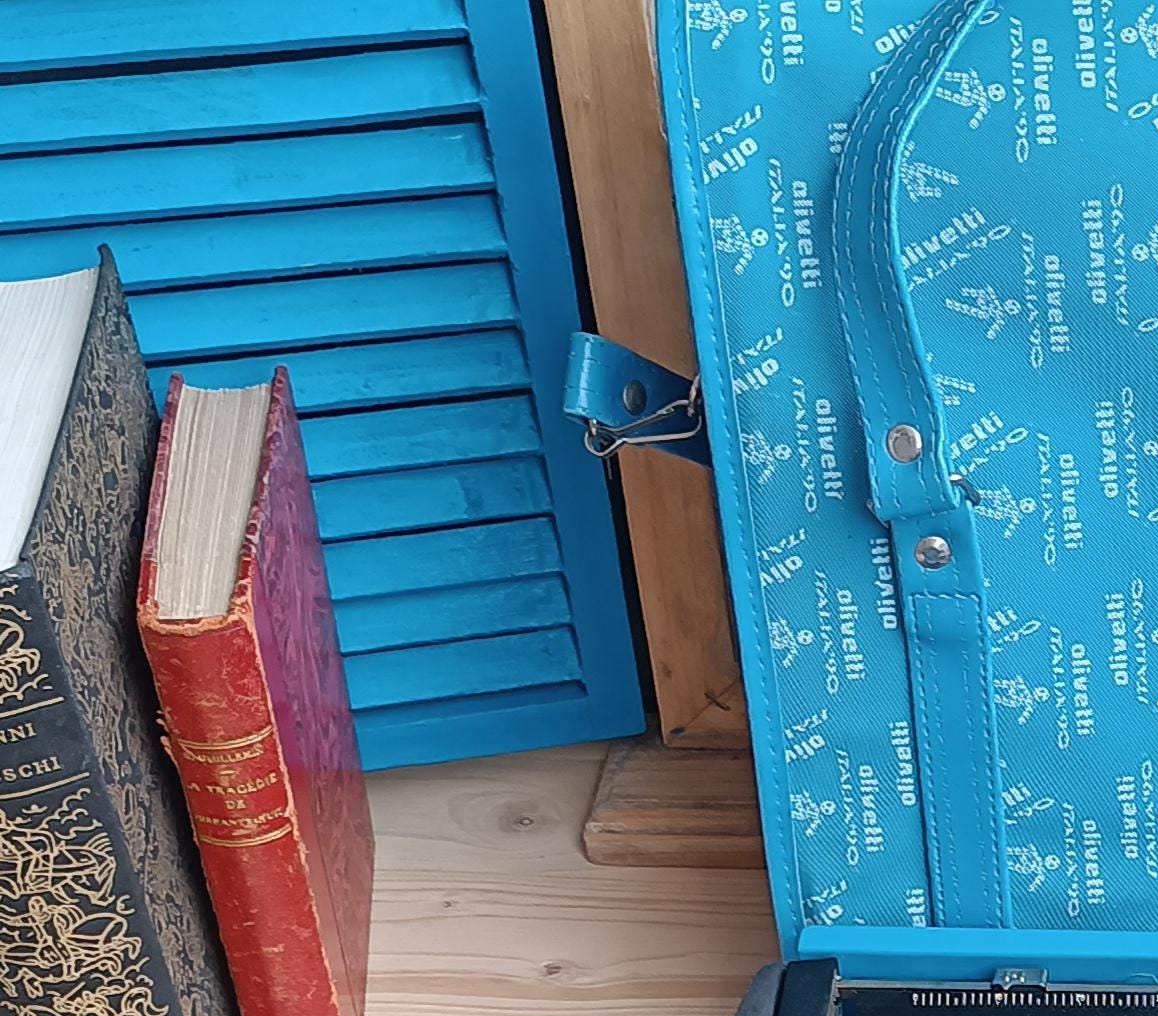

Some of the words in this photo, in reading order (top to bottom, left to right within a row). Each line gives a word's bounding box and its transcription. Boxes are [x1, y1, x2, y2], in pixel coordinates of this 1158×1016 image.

[780, 0, 804, 66] vetti
[1031, 38, 1058, 146] olivetti
[791, 181, 823, 289] olivetti
[1082, 200, 1107, 304] olivetti
[1044, 254, 1071, 354] olivetti
[0, 756, 62, 782] SCHI
